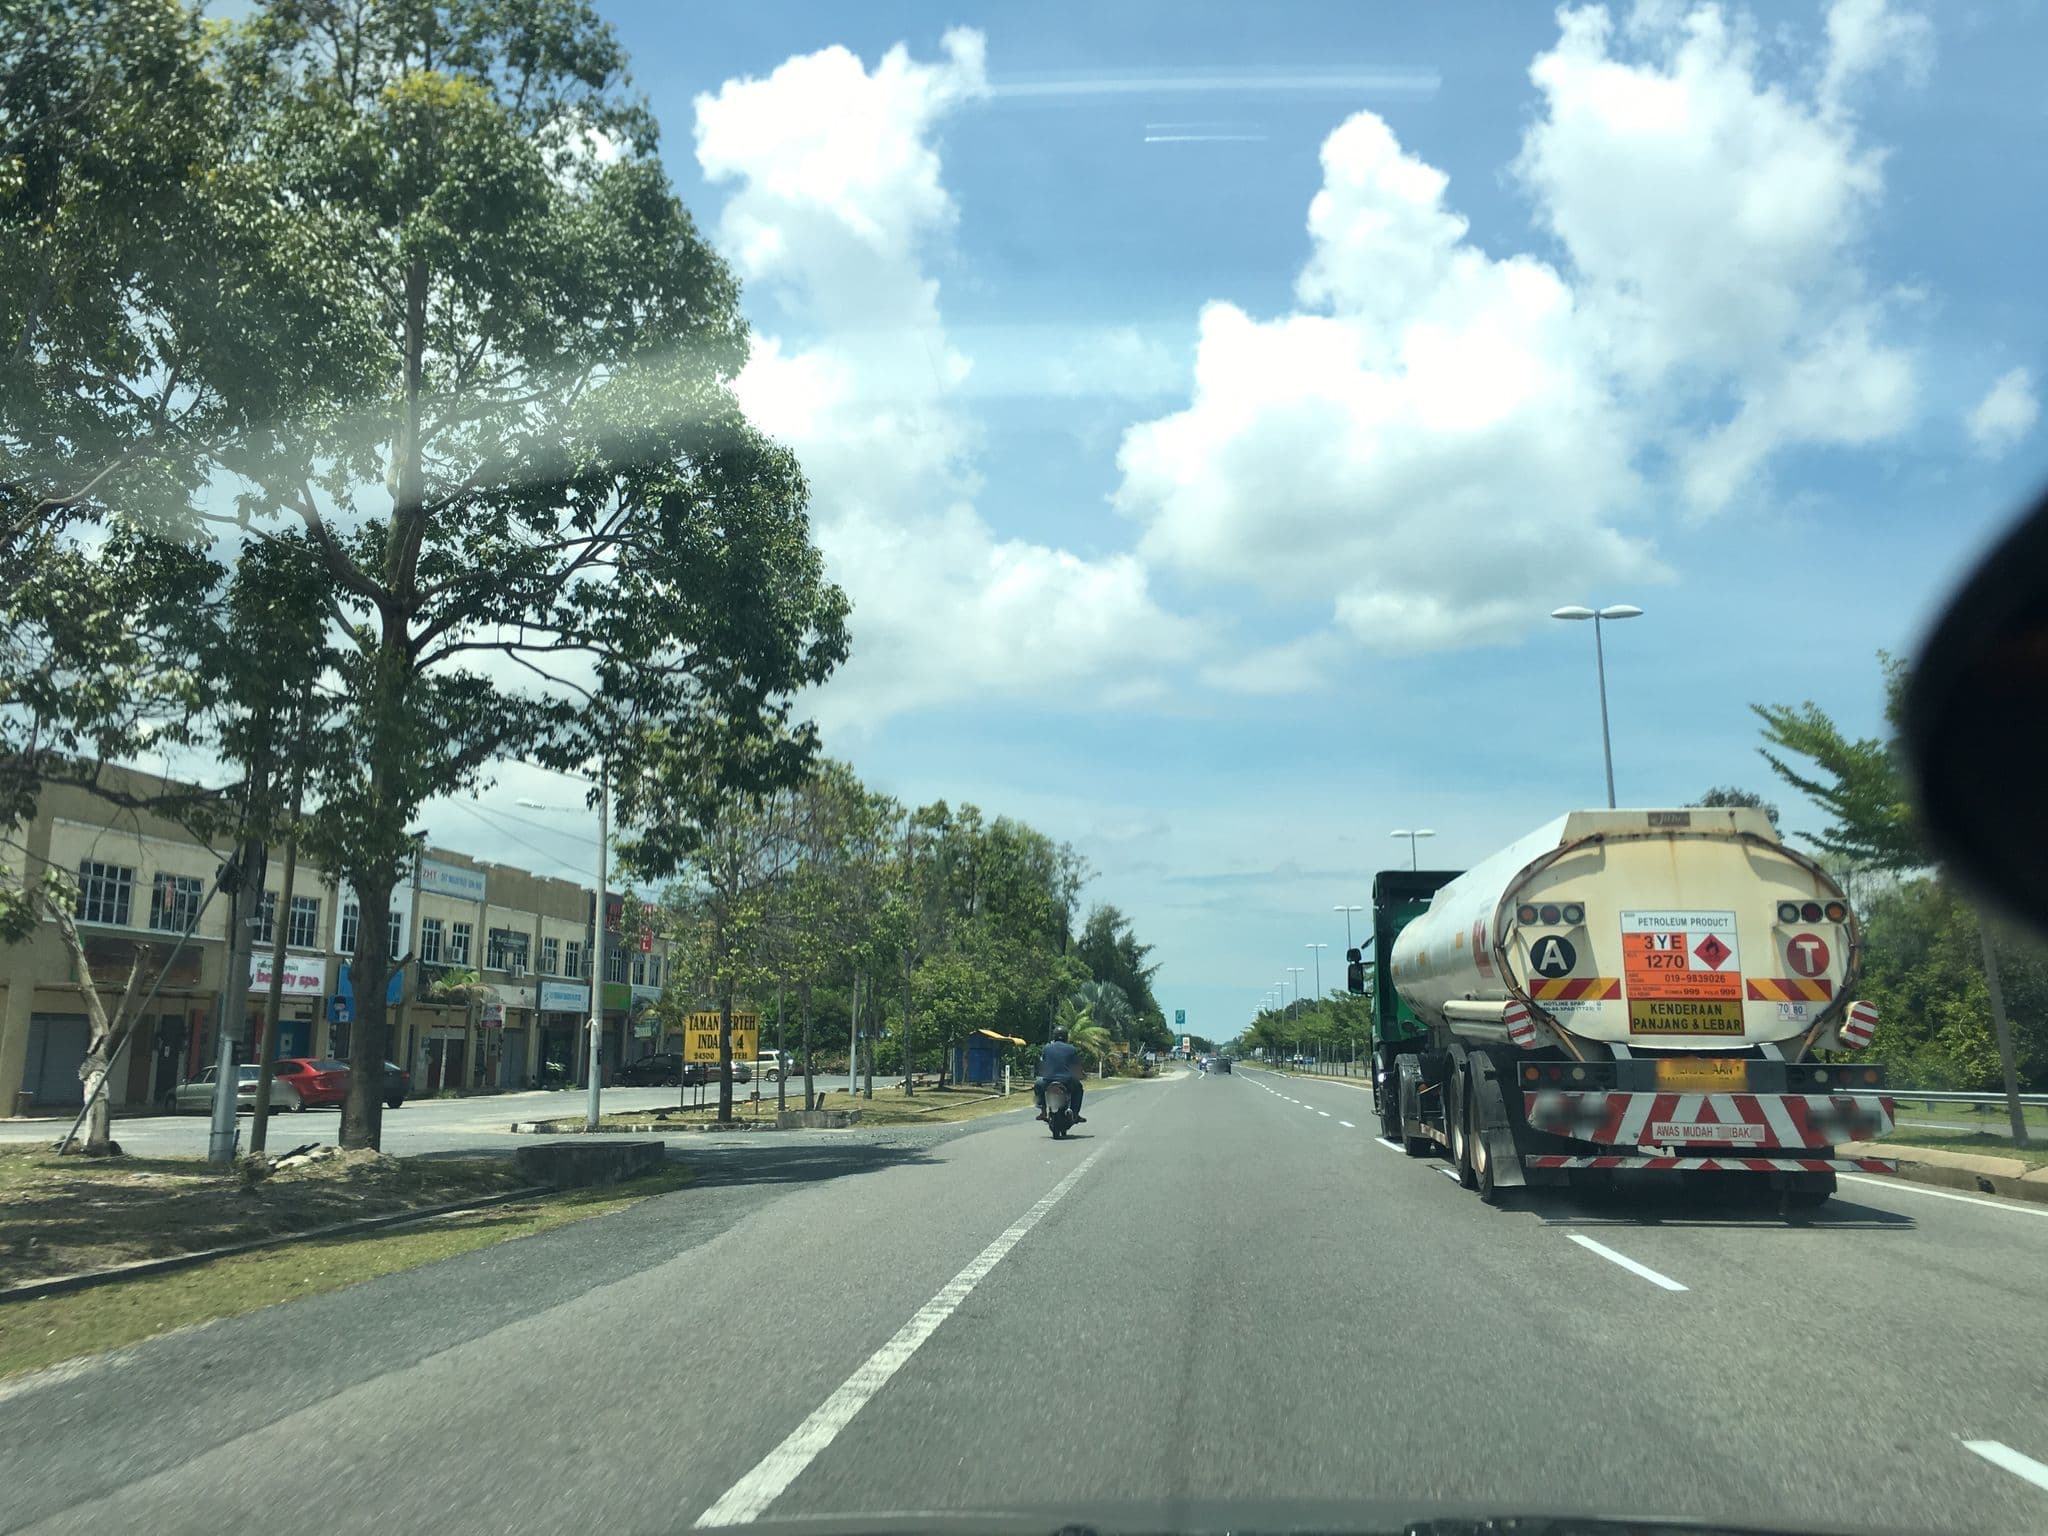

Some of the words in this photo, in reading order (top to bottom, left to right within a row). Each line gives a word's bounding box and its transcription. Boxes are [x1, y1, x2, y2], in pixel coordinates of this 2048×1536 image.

[1638, 917, 1687, 927] PETROLEUM
[1690, 917, 1729, 927] PRODUCT
[1539, 939, 1568, 970] A
[1796, 941, 1820, 973] T
[1645, 955, 1685, 969] 1270
[299, 975, 320, 989] spa
[1664, 974, 1726, 984] 019-9839026
[1683, 988, 1700, 996] 999
[1719, 988, 1736, 996] 999
[1650, 1003, 1722, 1015] KENDERAAN
[1778, 1003, 1789, 1014] 70
[689, 1015, 720, 1031] TAMAN
[730, 1015, 756, 1031] ERTEH
[1633, 1018, 1688, 1030] PANJANG
[1693, 1018, 1700, 1030] &
[1703, 1018, 1741, 1030] LEBAR
[698, 1034, 720, 1049] INDA
[736, 1034, 744, 1049] 4
[1656, 1125, 1680, 1137] AWAS
[1683, 1126, 1713, 1138] MUDAH
